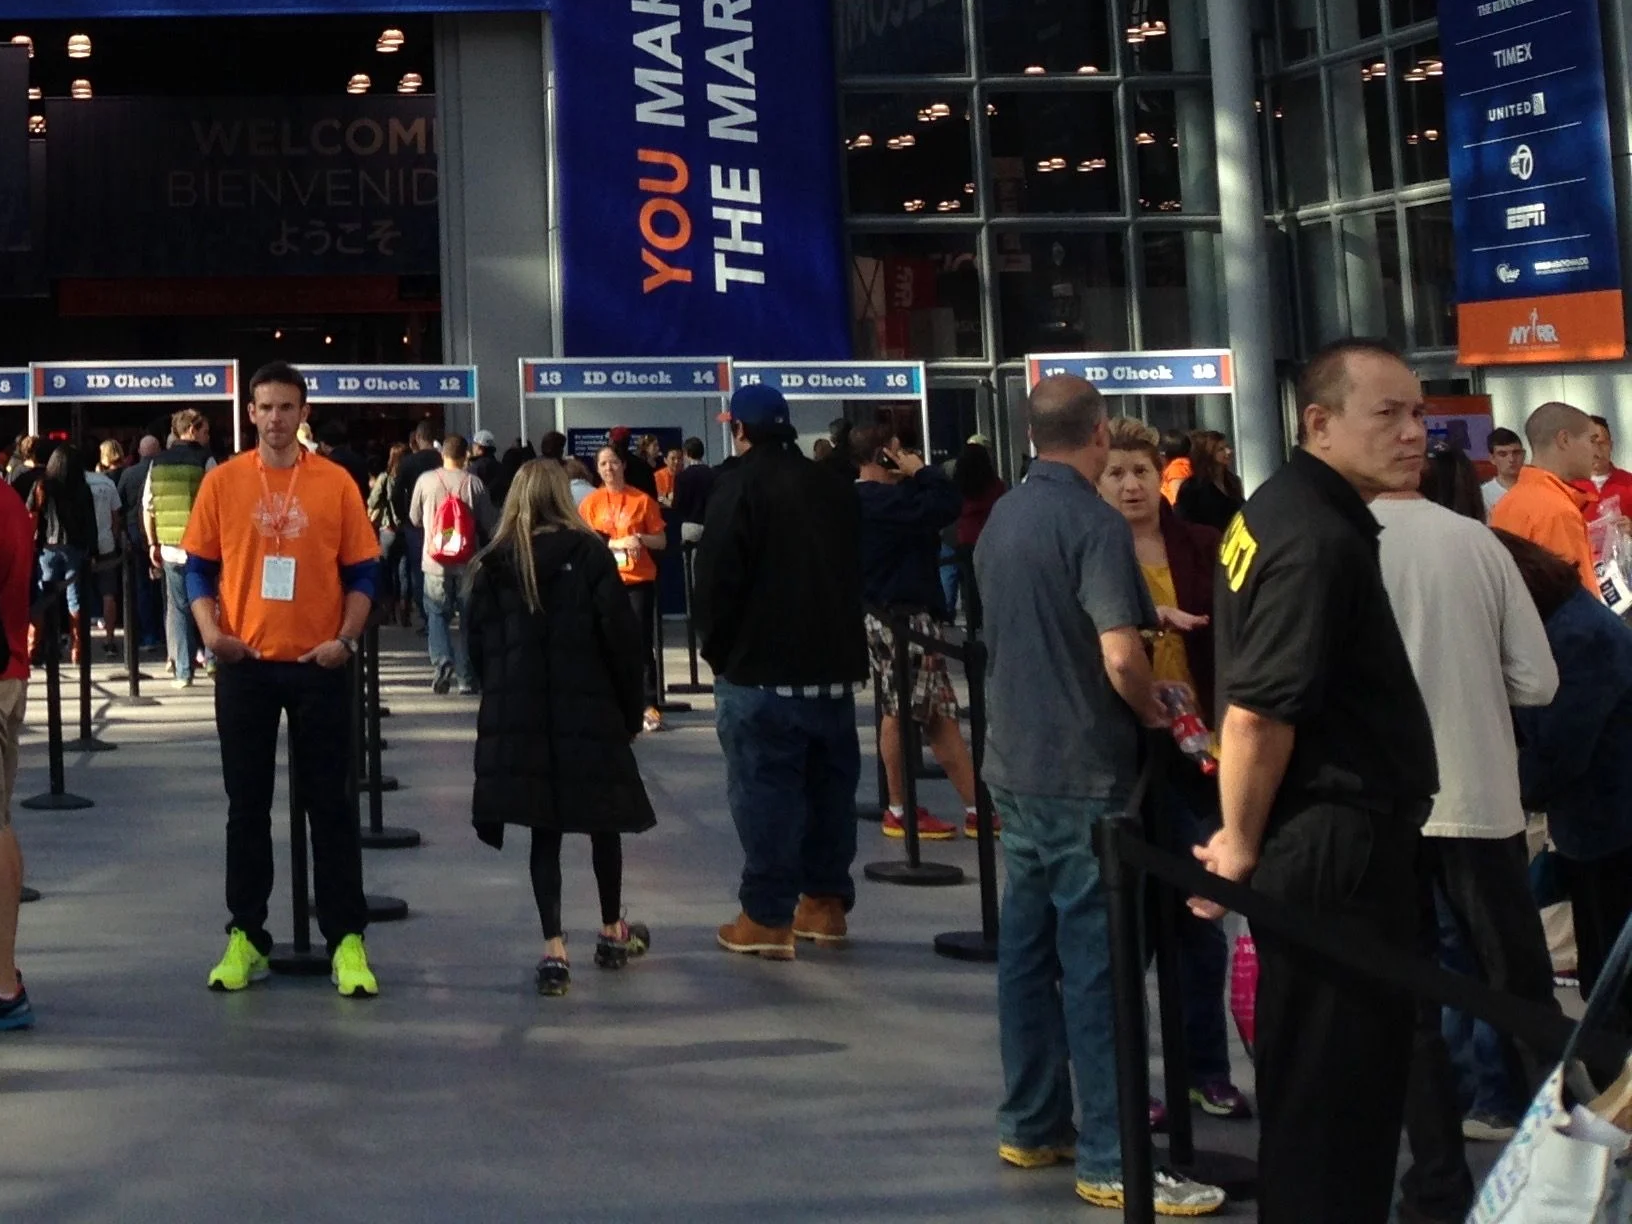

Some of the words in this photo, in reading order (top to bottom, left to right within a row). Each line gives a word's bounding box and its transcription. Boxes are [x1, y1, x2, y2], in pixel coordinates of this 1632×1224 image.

[1493, 42, 1533, 68] TIMEX
[1487, 102, 1531, 122] UNITED
[191, 117, 437, 156] WELCOM
[637, 148, 693, 295] YOU
[1507, 203, 1545, 229] ESPN
[270, 219, 402, 256] ようこそ
[710, 164, 765, 293] THE
[53, 376, 66, 388] 9
[87, 374, 110, 388] ID
[114, 373, 174, 388] Check
[194, 373, 217, 387] 10
[337, 377, 360, 390] ID
[364, 376, 420, 390] Check
[440, 377, 461, 390] 12
[539, 371, 562, 385] 13
[583, 371, 607, 385] ID
[611, 370, 672, 385] Check
[693, 370, 715, 384] 14
[781, 374, 804, 387] ID
[808, 373, 866, 387] Check
[886, 374, 908, 387] 16
[1085, 367, 1108, 381] ID
[1112, 365, 1173, 380] Check
[0, 380, 11, 393] 8
